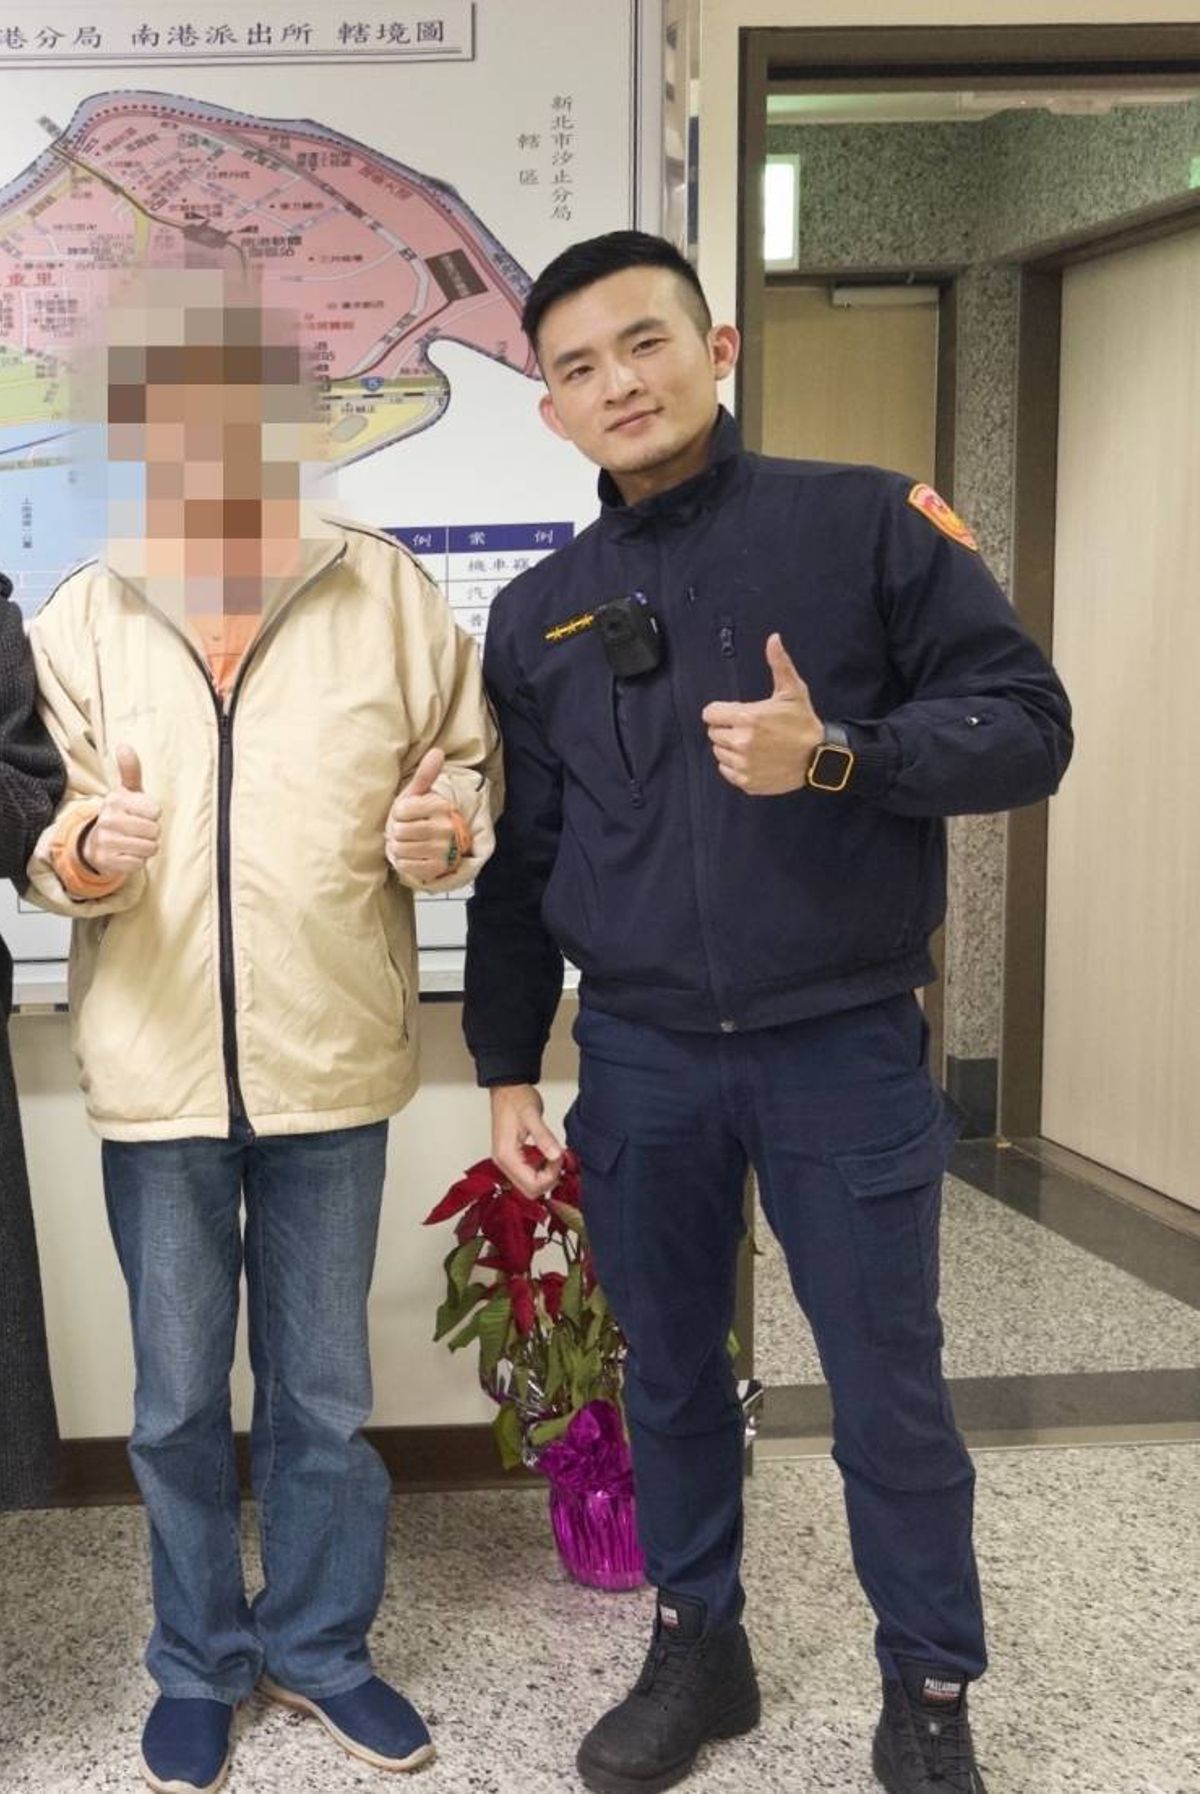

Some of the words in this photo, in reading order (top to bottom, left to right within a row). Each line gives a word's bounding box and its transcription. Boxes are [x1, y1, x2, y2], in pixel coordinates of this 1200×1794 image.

[131, 22, 315, 47] 南港派出所
[338, 20, 445, 45] 轄境圖
[552, 95, 575, 222] 新北市汐止分局
